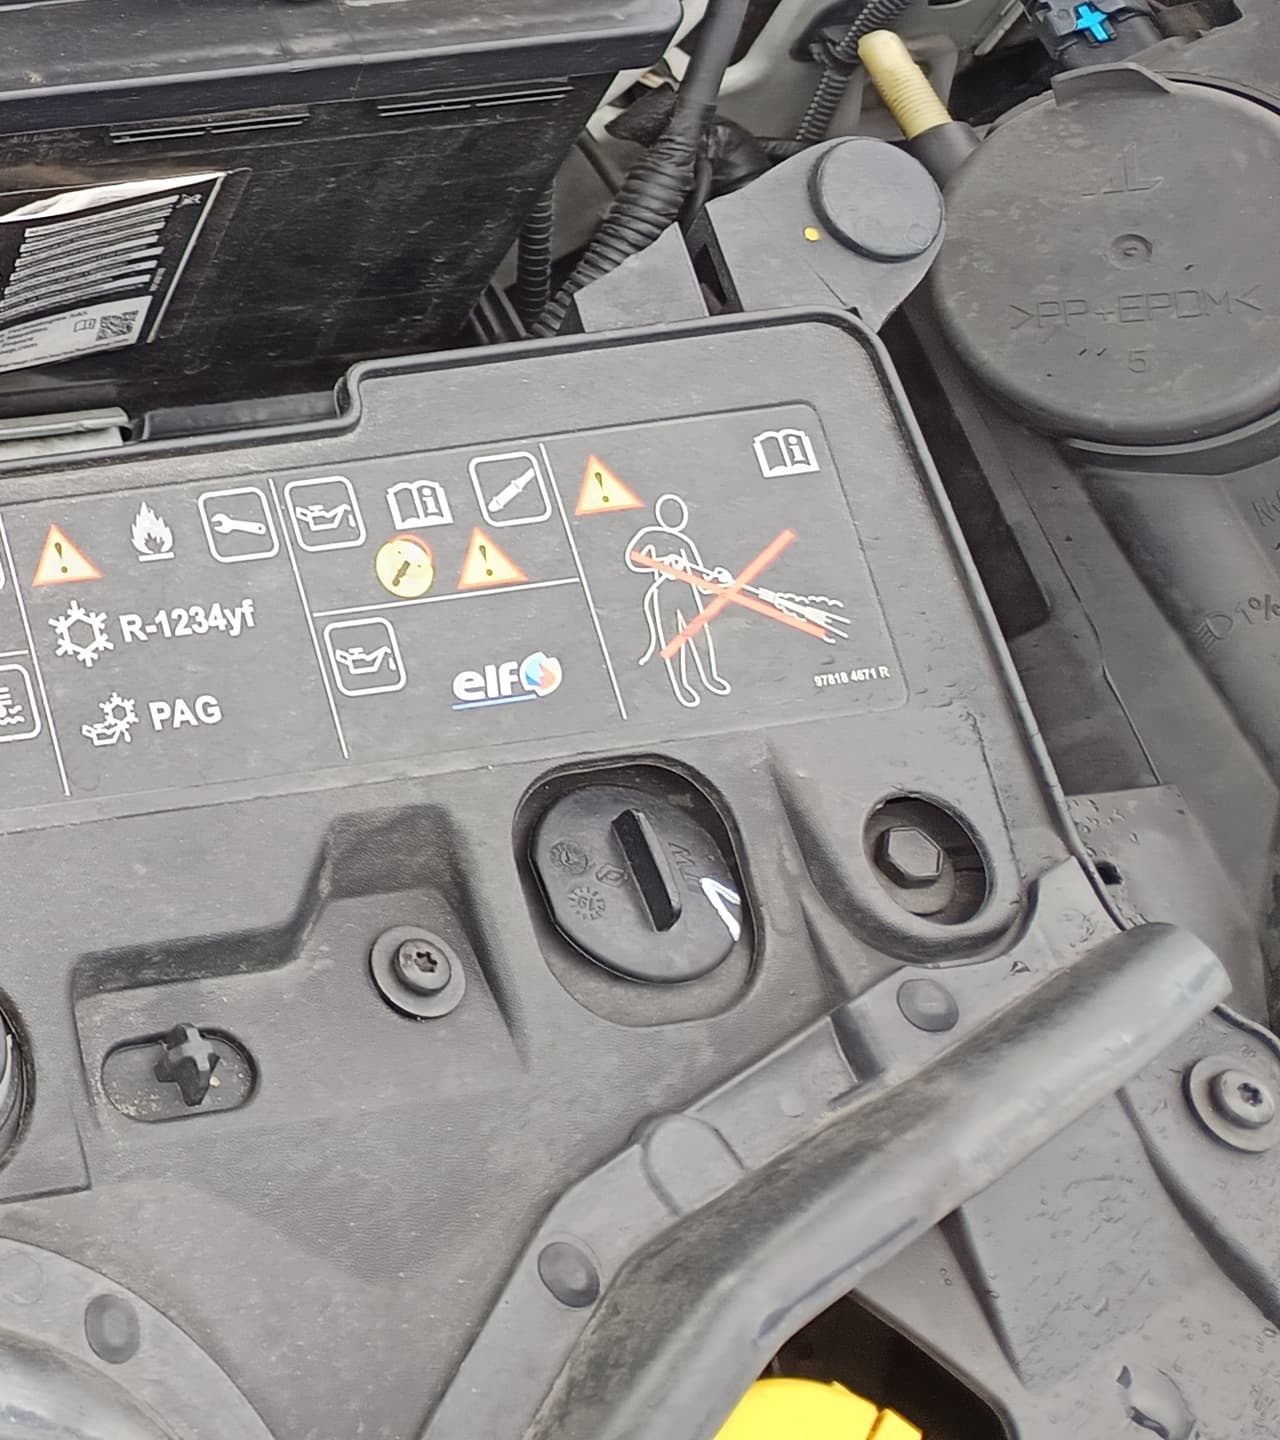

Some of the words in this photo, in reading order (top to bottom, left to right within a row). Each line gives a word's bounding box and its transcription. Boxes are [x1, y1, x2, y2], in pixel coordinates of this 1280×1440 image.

[118, 597, 257, 643] R-1234yf
[451, 663, 522, 702] elf
[878, 665, 892, 679] R
[147, 693, 223, 731] PAG
